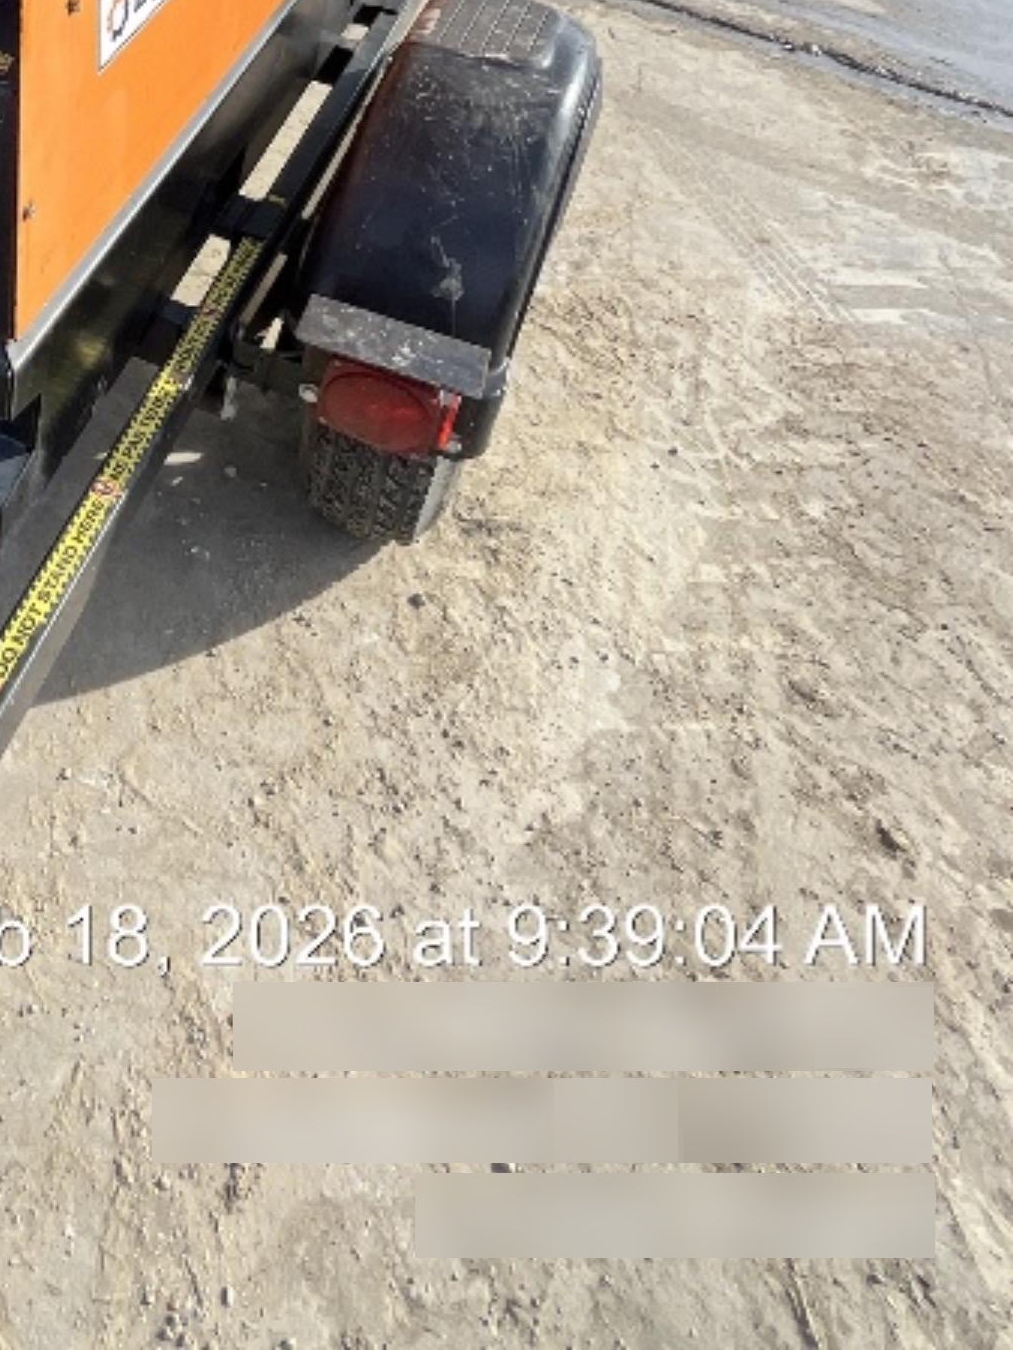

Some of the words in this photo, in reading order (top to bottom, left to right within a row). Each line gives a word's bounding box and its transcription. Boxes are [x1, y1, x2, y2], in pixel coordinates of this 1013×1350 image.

[16, 603, 43, 645] NOT
[38, 544, 79, 602] STAND
[71, 500, 105, 544] HERE
